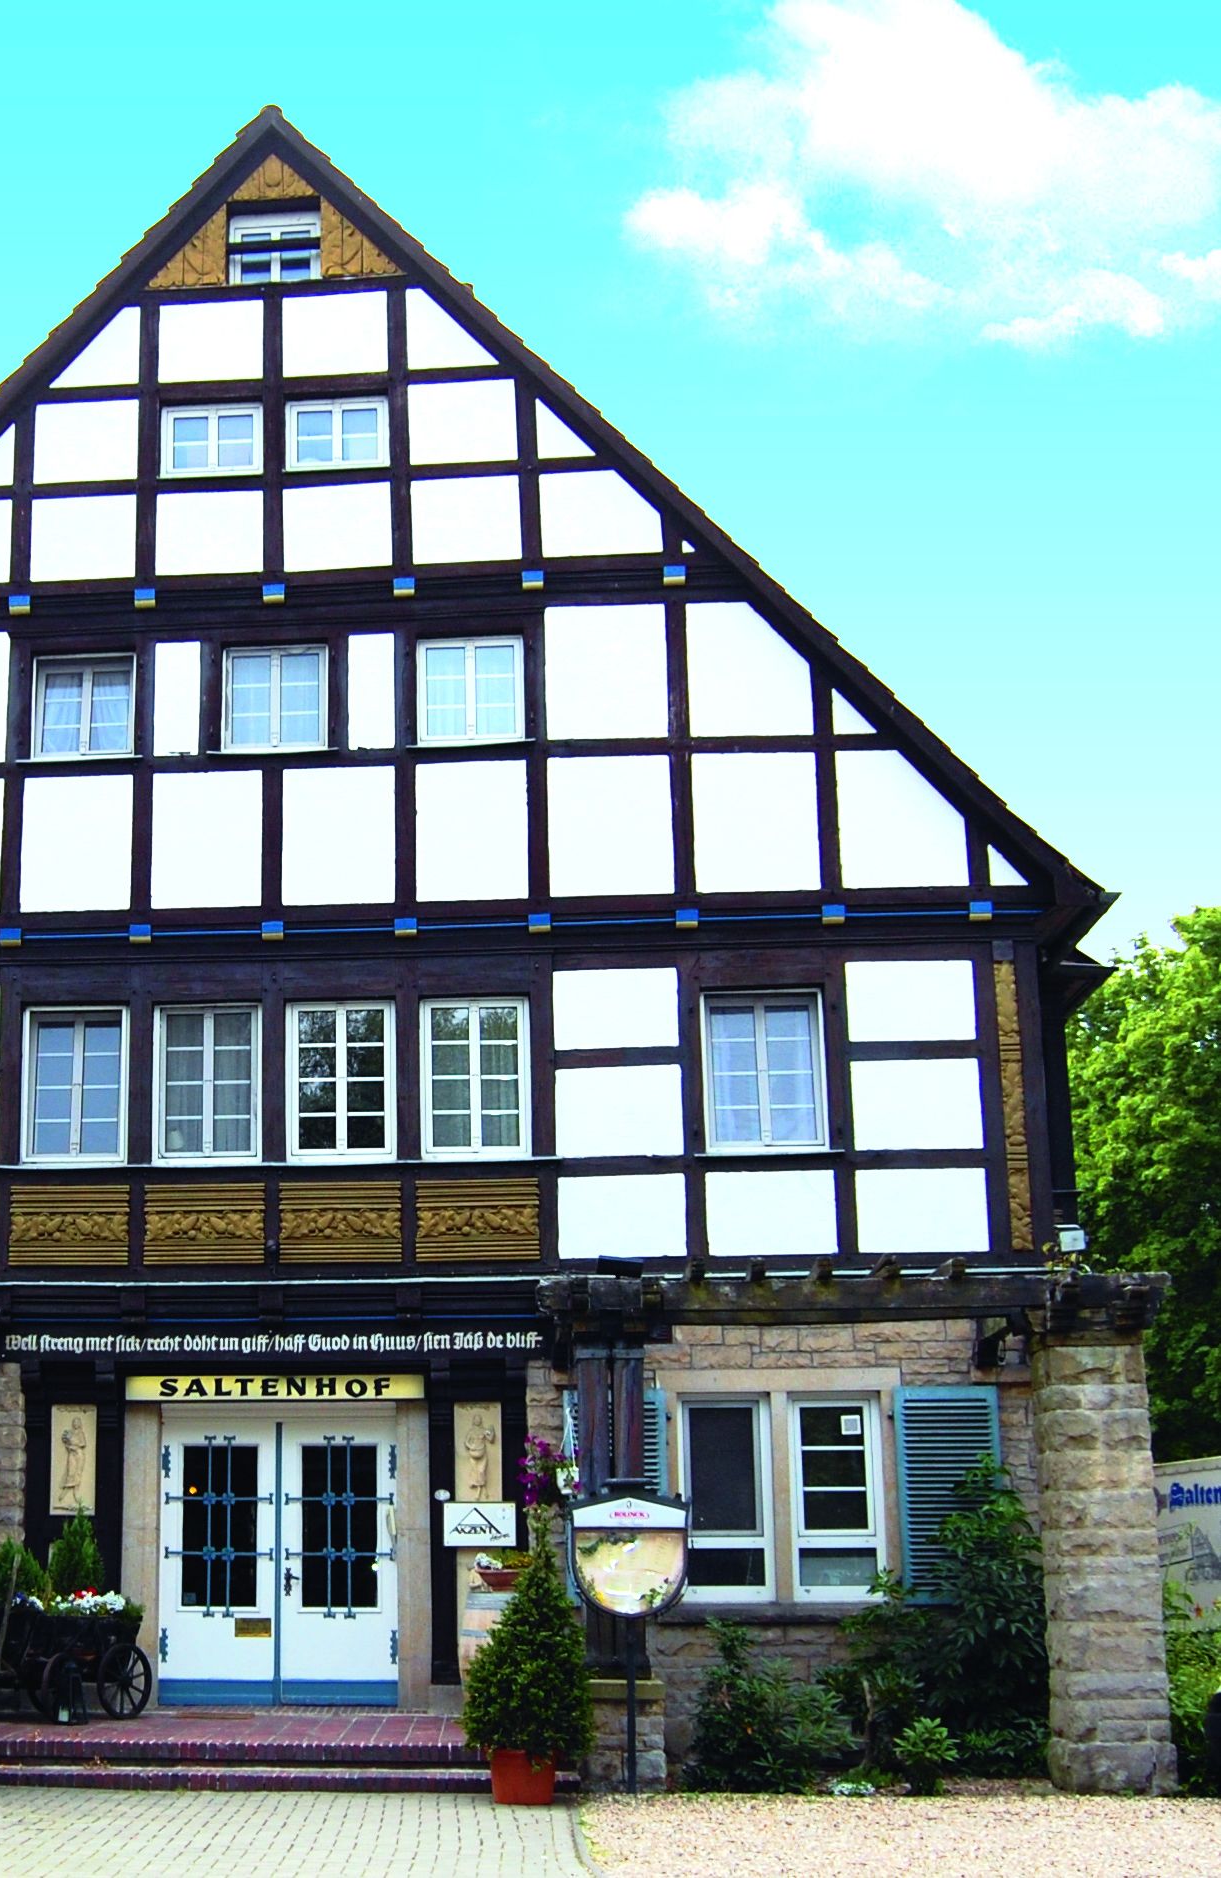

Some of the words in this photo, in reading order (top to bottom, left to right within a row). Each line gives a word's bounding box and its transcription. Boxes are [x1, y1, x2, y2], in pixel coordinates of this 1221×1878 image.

[6, 1335, 38, 1351] Well
[86, 1335, 114, 1351] met
[219, 1337, 239, 1351] un
[353, 1334, 368, 1350] in
[487, 1331, 504, 1348] de
[158, 1376, 391, 1398] SALTENHOF
